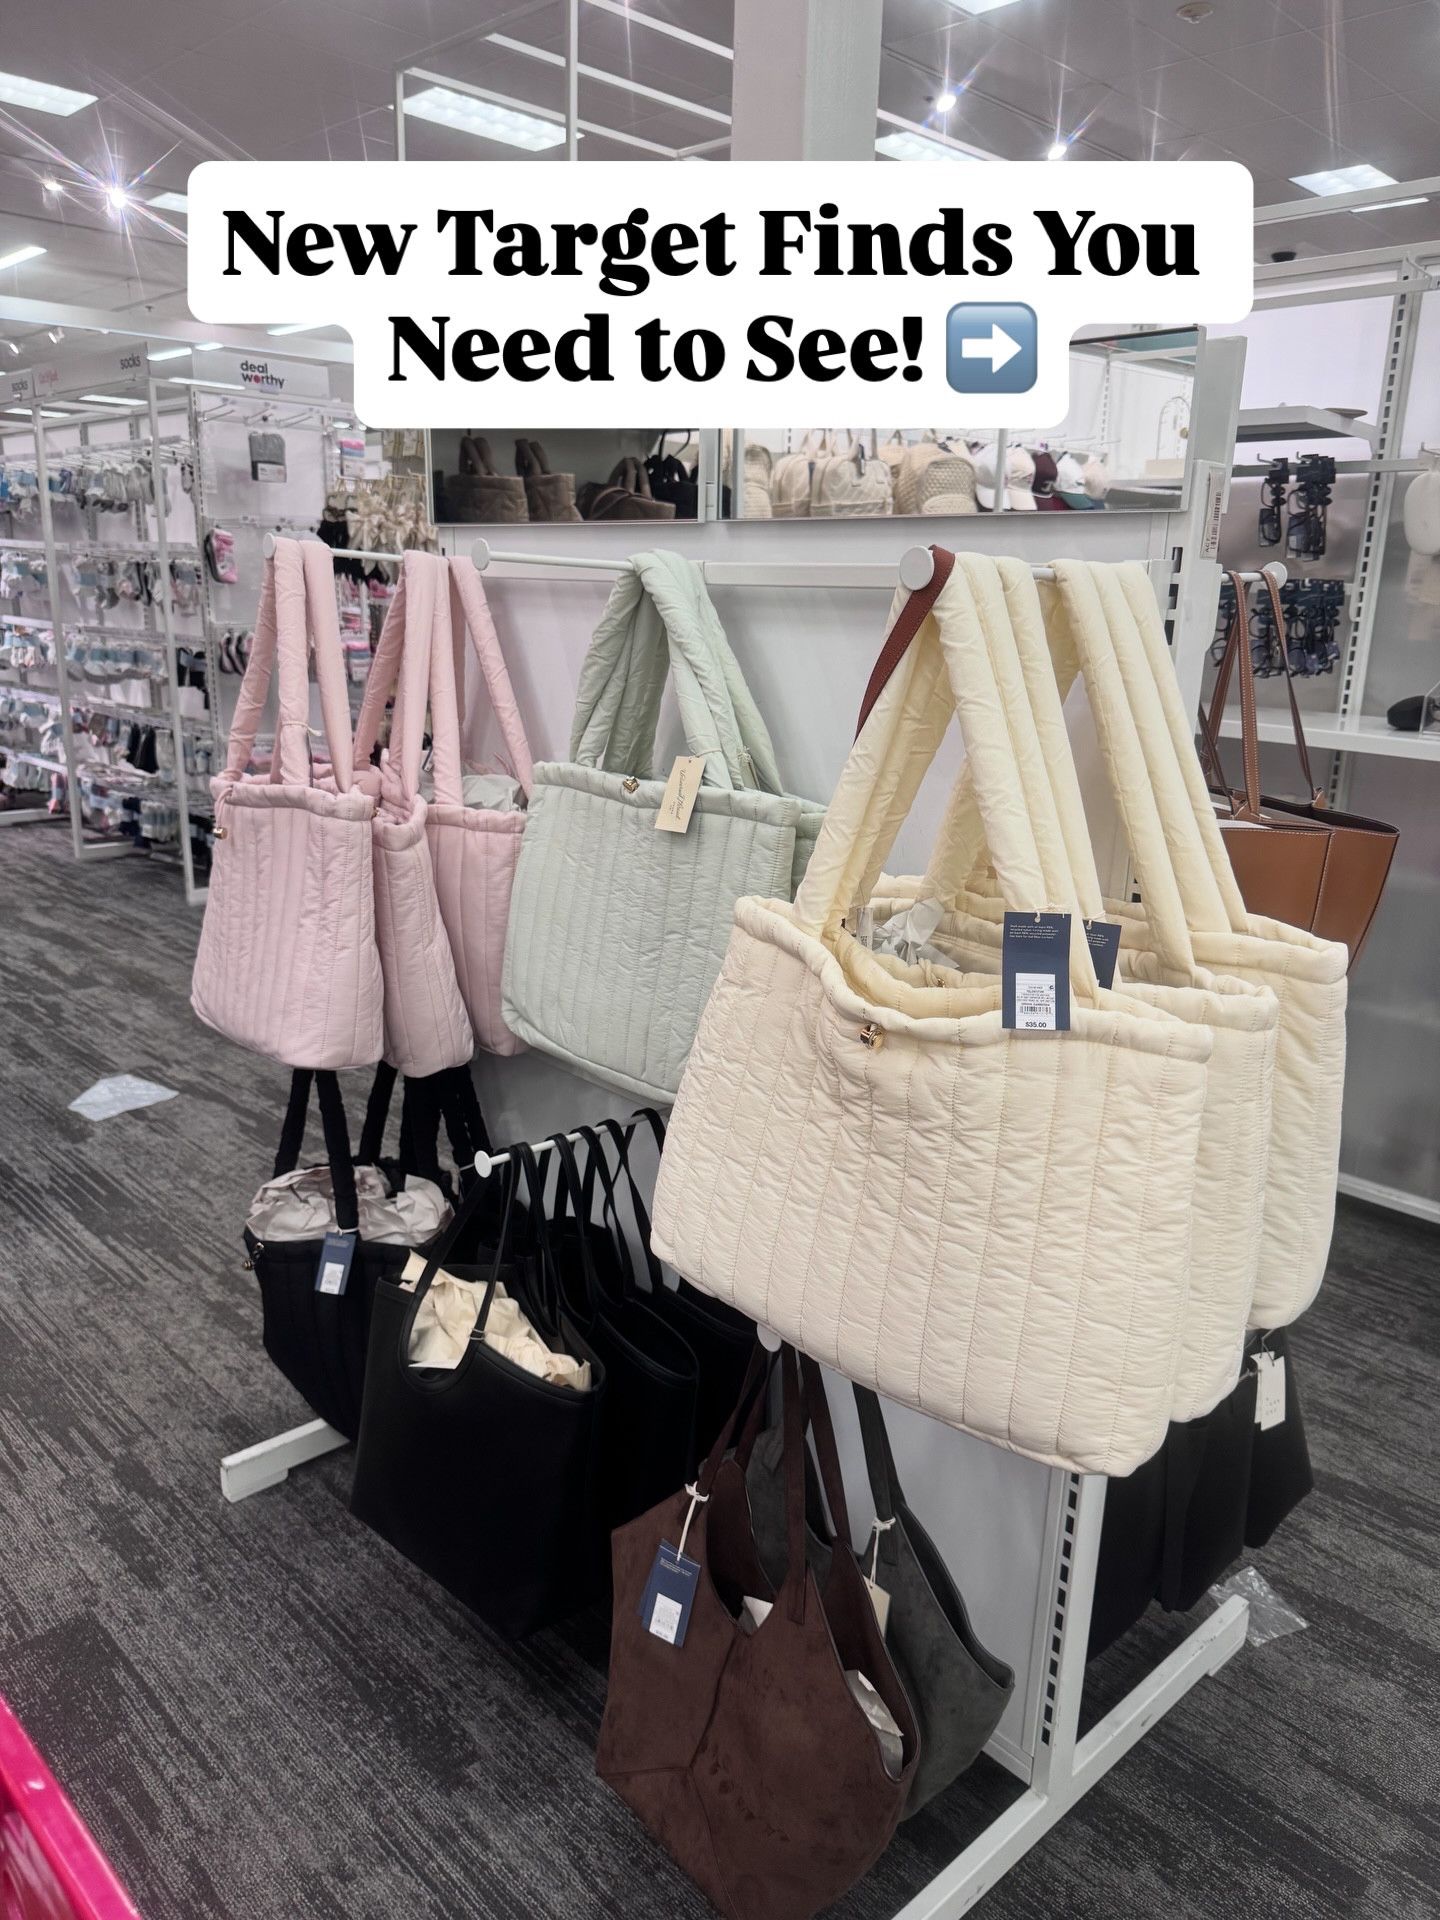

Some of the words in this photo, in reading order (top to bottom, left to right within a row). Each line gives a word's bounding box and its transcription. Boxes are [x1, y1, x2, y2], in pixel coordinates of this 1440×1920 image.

[119, 353, 141, 370] socks
[240, 360, 268, 374] deal
[241, 372, 285, 389] worthy
